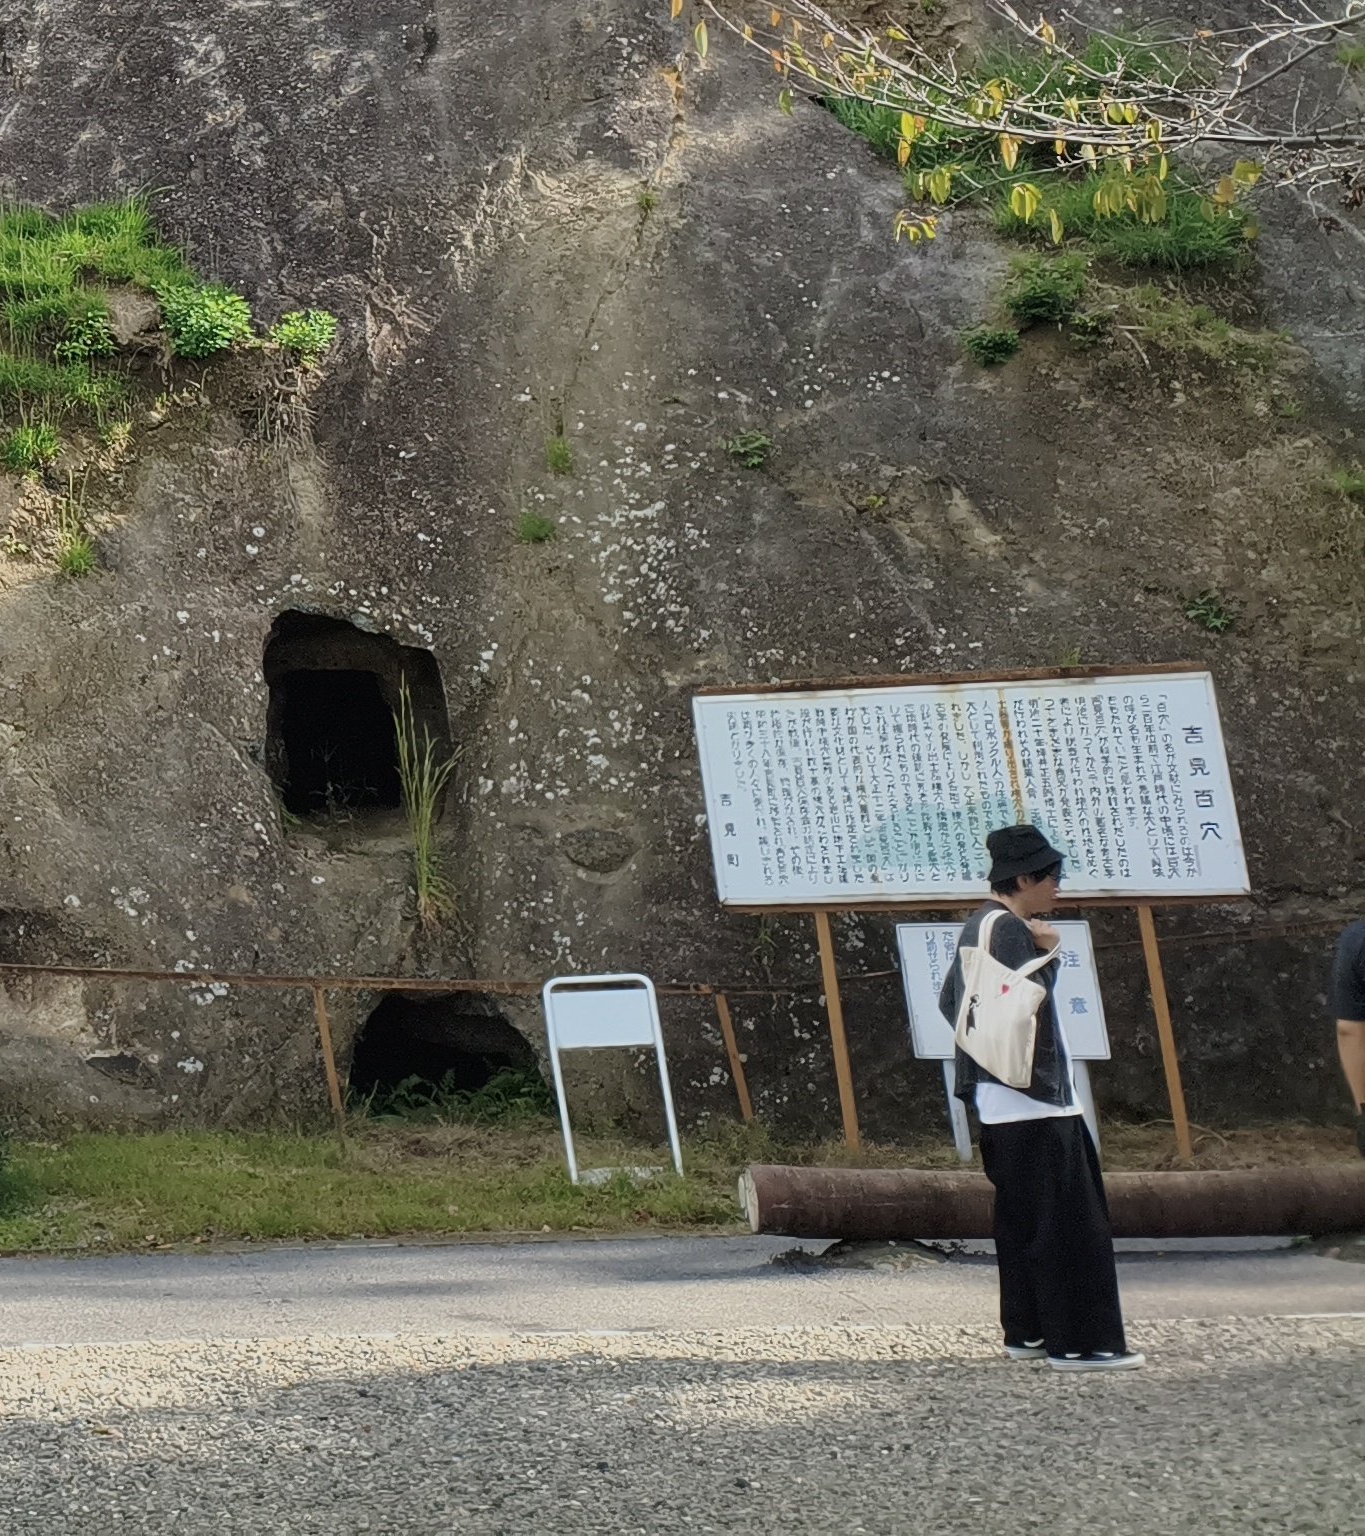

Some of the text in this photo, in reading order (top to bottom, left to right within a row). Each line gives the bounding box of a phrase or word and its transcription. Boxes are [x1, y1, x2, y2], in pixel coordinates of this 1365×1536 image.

[1181, 725, 1223, 842] 吉見百穴
[1060, 950, 1088, 1014] 注意
